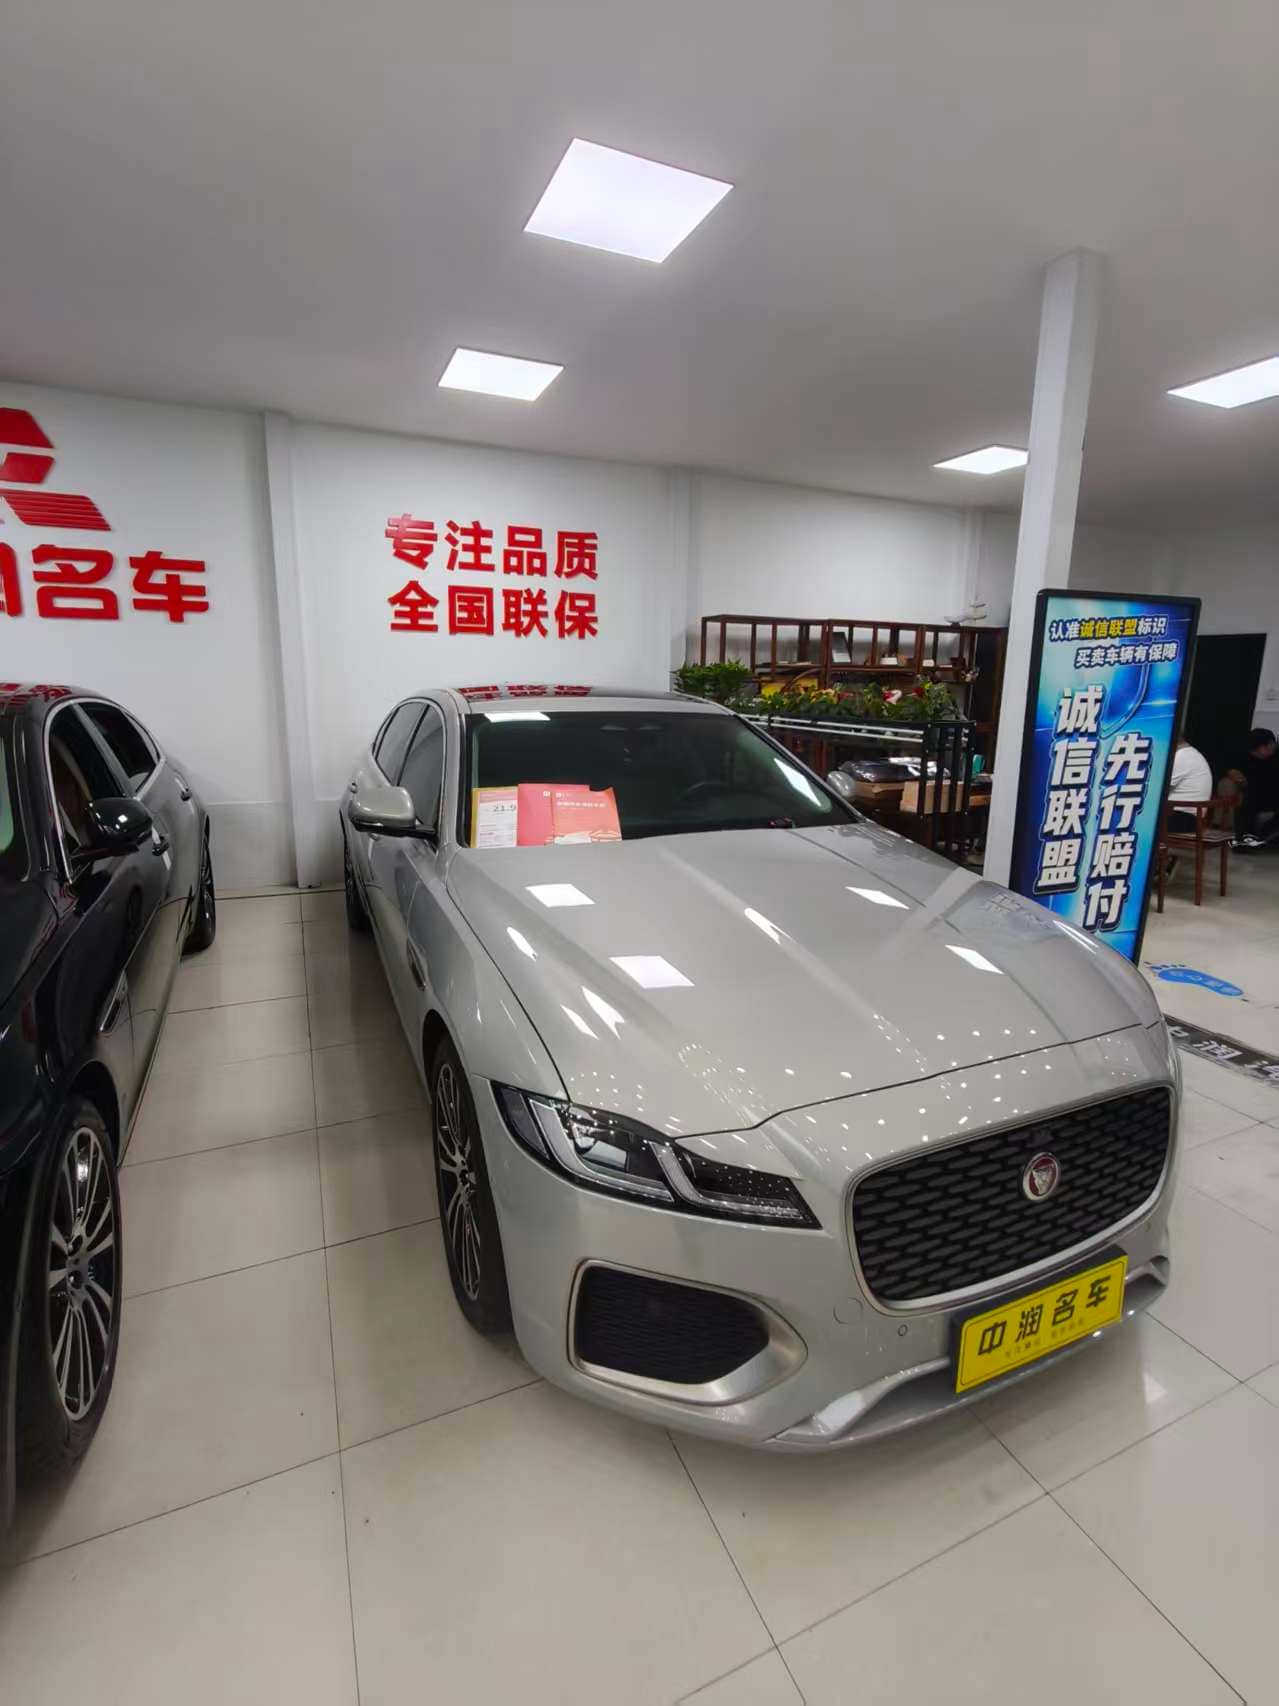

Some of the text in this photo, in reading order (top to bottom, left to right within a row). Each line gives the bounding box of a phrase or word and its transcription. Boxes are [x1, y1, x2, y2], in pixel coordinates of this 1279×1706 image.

[384, 513, 599, 581] 专注品质
[388, 580, 599, 640] 全国联保
[1050, 617, 1166, 639] 认准诚信联盟标识
[1075, 642, 1178, 667] 买卖车辆有保障
[1037, 684, 1103, 888] 诚信联盟
[1085, 732, 1151, 927] 先行赔付
[977, 1274, 1112, 1356] 中润名车
